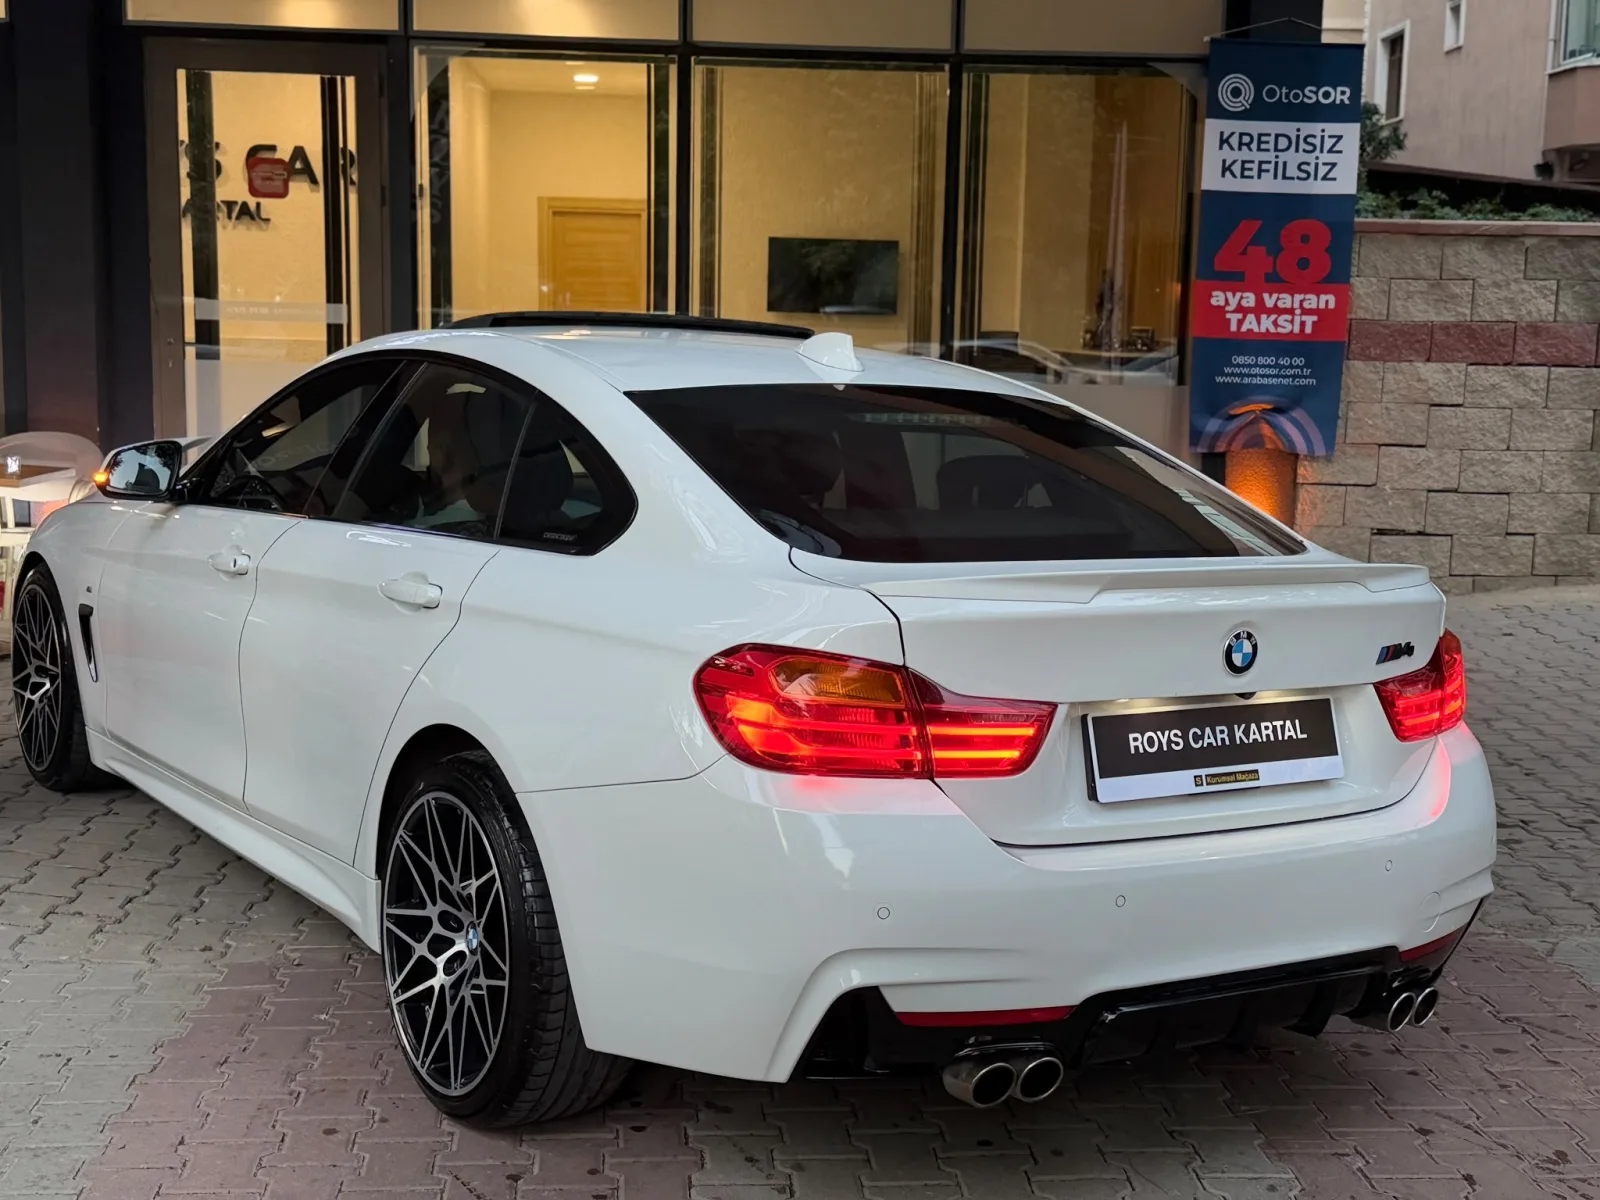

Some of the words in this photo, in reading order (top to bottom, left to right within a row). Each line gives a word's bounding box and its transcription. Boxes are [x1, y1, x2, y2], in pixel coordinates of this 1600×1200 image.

[1262, 84, 1351, 105] OtoSOR
[1218, 127, 1344, 155] KREDİSİZ
[1220, 154, 1338, 182] KEFİLSİZ
[1214, 218, 1332, 285] 48
[1210, 290, 1256, 311] aya
[1262, 292, 1336, 309] varan
[1225, 309, 1318, 334] TAKSİT
[1223, 366, 1312, 376] www.otosor.com.tr
[1231, 355, 1256, 365] 0850
[1257, 356, 1276, 366] 800
[1277, 356, 1291, 366] 40
[1291, 357, 1305, 366] 00
[1214, 376, 1316, 386] www.arabasenet.com
[1128, 728, 1184, 755] ROYS
[1188, 725, 1230, 750] CAR
[1234, 718, 1308, 745] KARTAL
